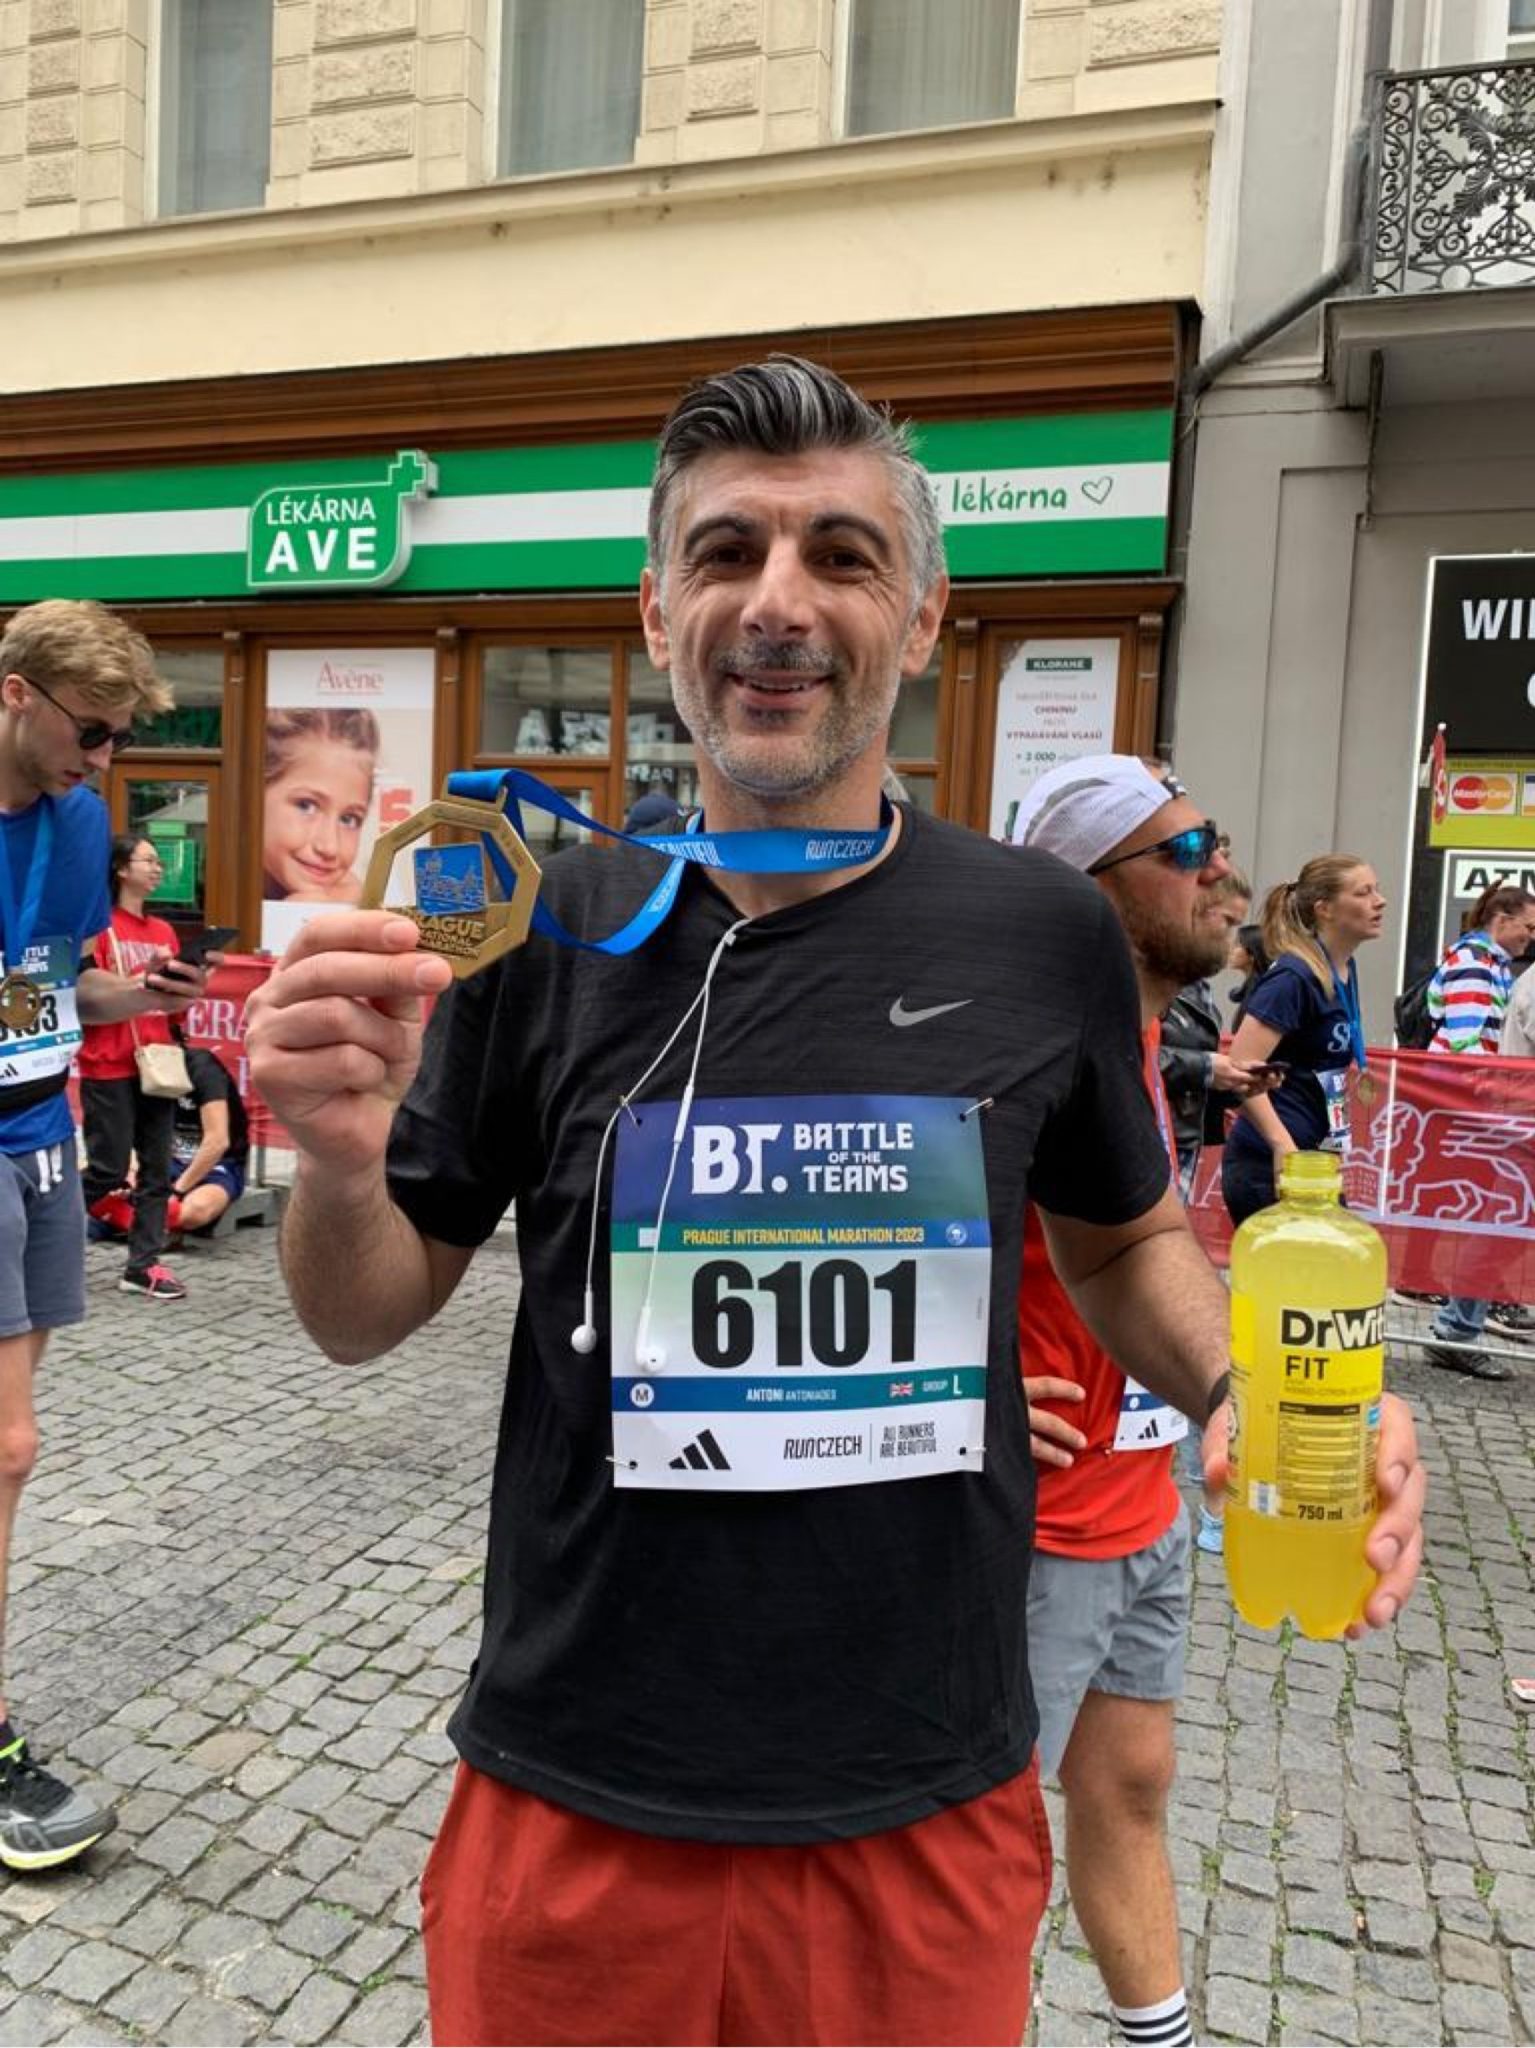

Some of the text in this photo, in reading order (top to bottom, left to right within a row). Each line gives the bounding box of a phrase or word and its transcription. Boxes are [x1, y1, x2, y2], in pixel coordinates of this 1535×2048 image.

[952, 476, 1068, 513] lékárna
[266, 493, 376, 526] LÉKÁRNA
[265, 527, 377, 573] AVE
[793, 1123, 914, 1150] BATTLE
[828, 1151, 882, 1164] OF THE
[802, 1165, 909, 1193] TEAMS
[683, 1226, 925, 1245] PRAGUE INTERNATIONAL MARATHON 2023
[691, 1258, 917, 1369] 6101
[1285, 1354, 1329, 1381] FIT
[745, 1387, 785, 1402] ANTONI
[953, 1374, 963, 1396] L
[783, 1435, 863, 1461] RUNCZECH
[1297, 1504, 1344, 1521] 750 ml
